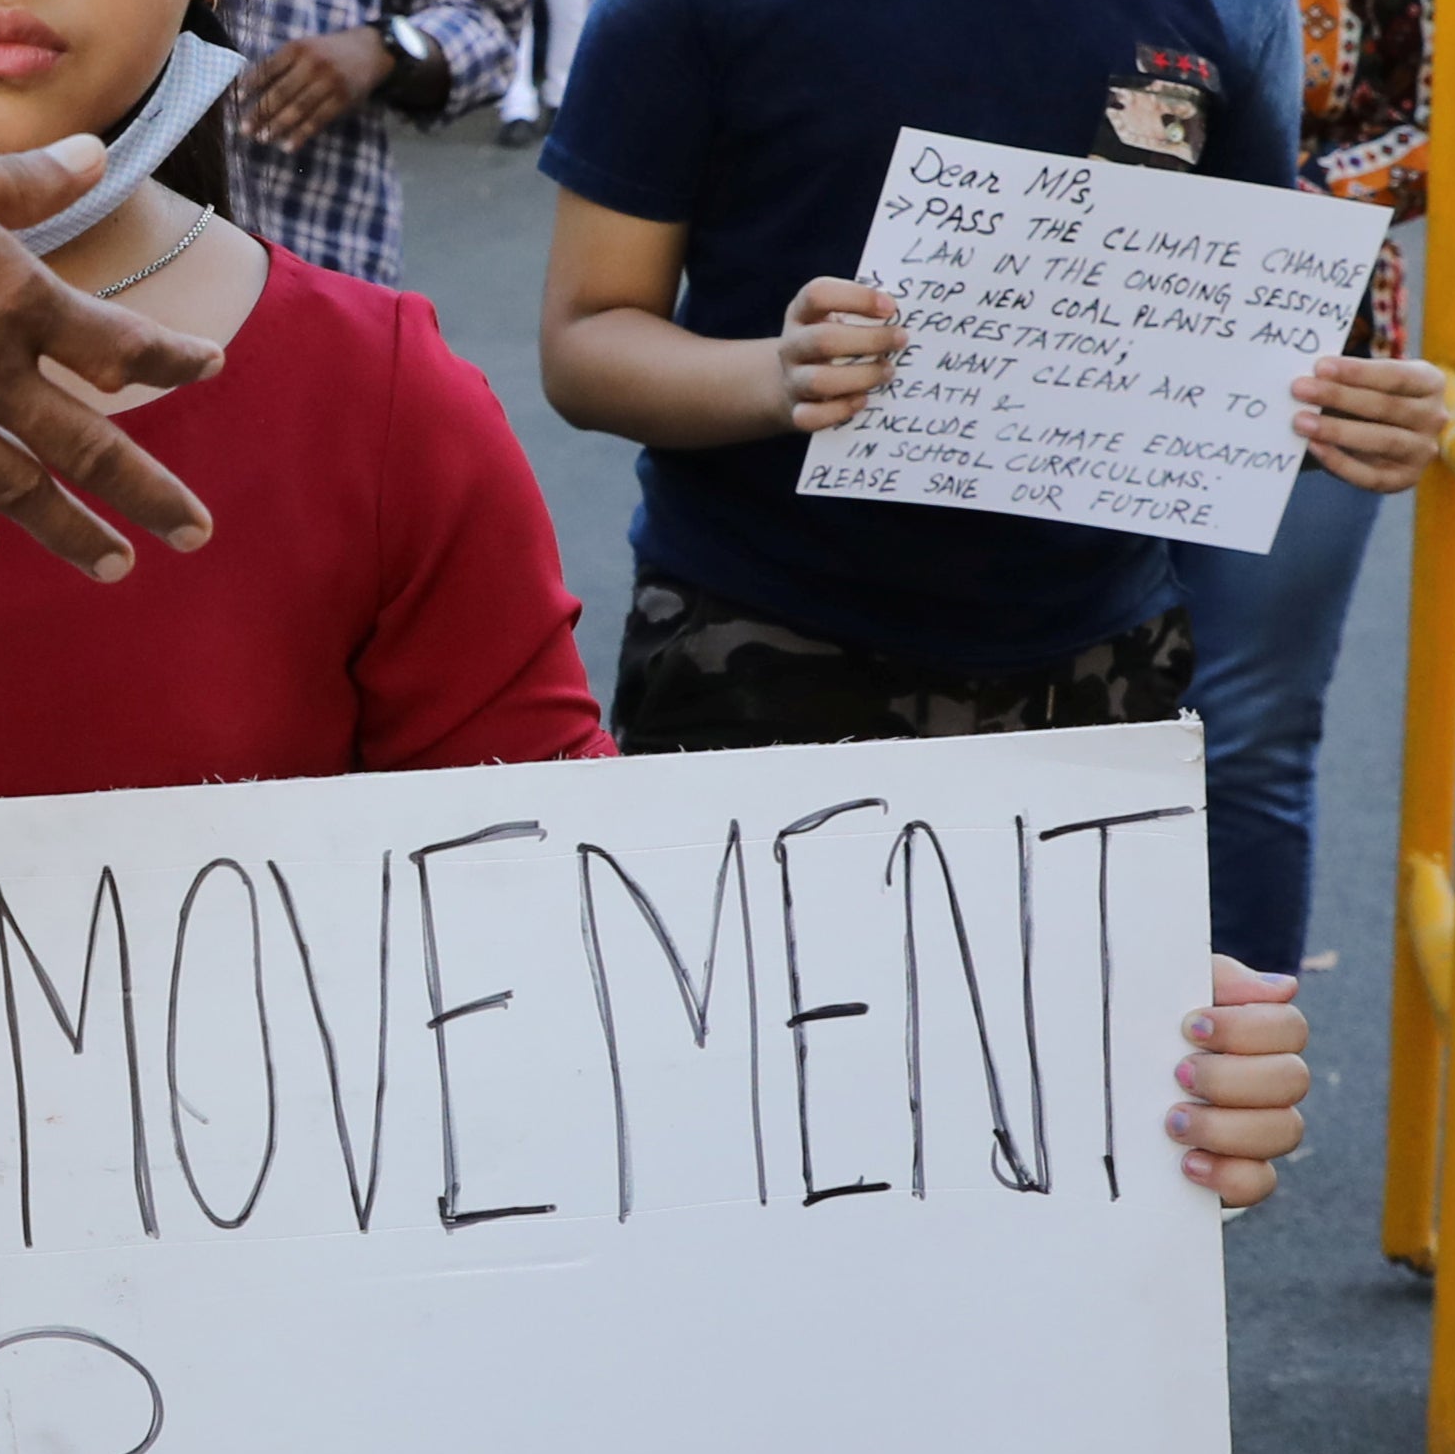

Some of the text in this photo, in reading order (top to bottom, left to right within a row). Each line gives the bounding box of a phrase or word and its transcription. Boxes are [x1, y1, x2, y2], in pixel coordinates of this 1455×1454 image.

[910, 146, 1095, 215] Dear MPs,
[900, 236, 976, 269] LAW
[993, 252, 1031, 277] IN
[1043, 255, 1107, 289] THE
[1124, 269, 1233, 315] ONGOING
[914, 196, 1369, 290] PASS THE CLIMATE CHANGE
[888, 277, 1321, 355] STOP NEW COAL PLANTS AND
[936, 350, 1018, 381] WANT
[1031, 363, 1141, 393] CLEAN
[1148, 375, 1206, 409] AIR
[1225, 392, 1268, 420] TO
[846, 441, 880, 460] IN
[888, 440, 995, 471] SCHOOL
[852, 406, 1297, 474] INCLUDE CLIMATE EDUCATION
[803, 464, 902, 494] PLEASE
[922, 471, 980, 500] SAVE
[1010, 483, 1065, 512] OUR
